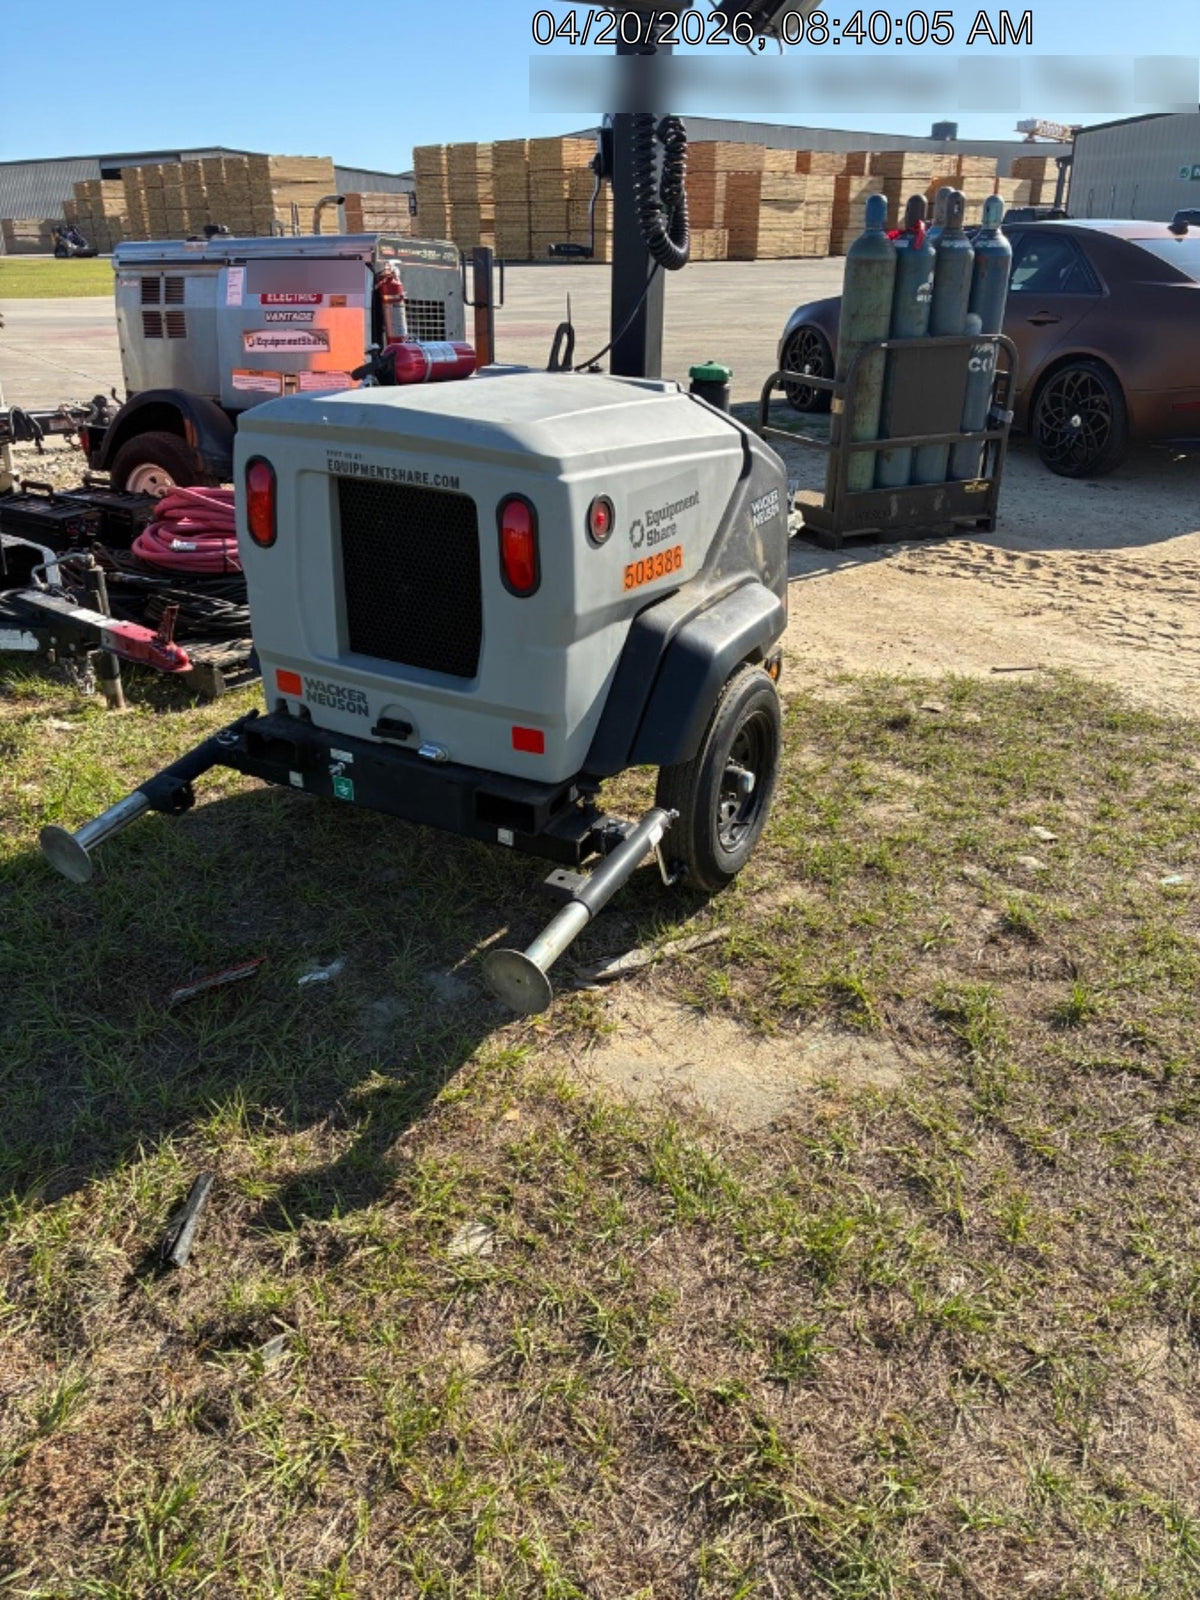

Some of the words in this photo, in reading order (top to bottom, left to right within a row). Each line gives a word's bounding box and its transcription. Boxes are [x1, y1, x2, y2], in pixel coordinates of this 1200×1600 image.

[264, 311, 315, 322] VANTAGE
[327, 458, 460, 489] EQUIPMENTSHARE.COM
[645, 490, 700, 527] Equipment
[646, 522, 677, 547] Share
[624, 545, 682, 588] 503386
[304, 676, 368, 705] WACKER
[305, 689, 369, 717] NEUSON
